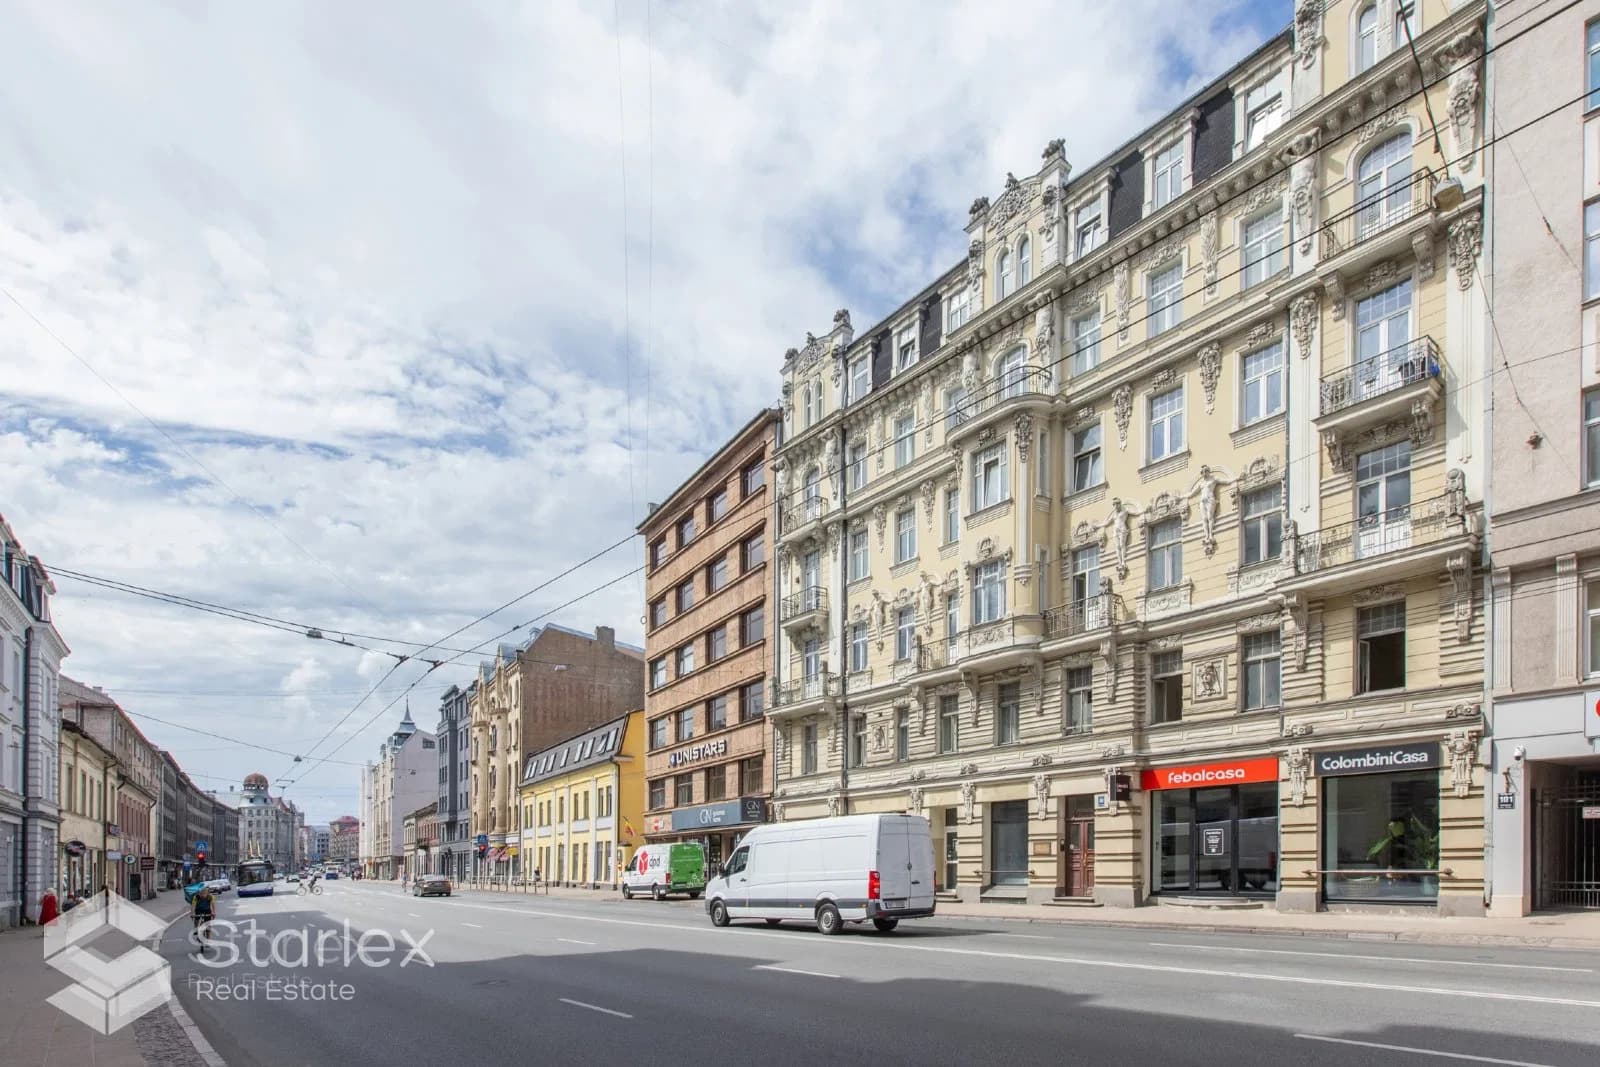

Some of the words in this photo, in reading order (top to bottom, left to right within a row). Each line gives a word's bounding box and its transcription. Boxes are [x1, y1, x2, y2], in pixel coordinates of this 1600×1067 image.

[676, 739, 726, 764] UNISTARS
[1321, 751, 1429, 770] ColombiniCasa
[1168, 768, 1245, 784] febalcasa
[649, 855, 661, 869] dpd
